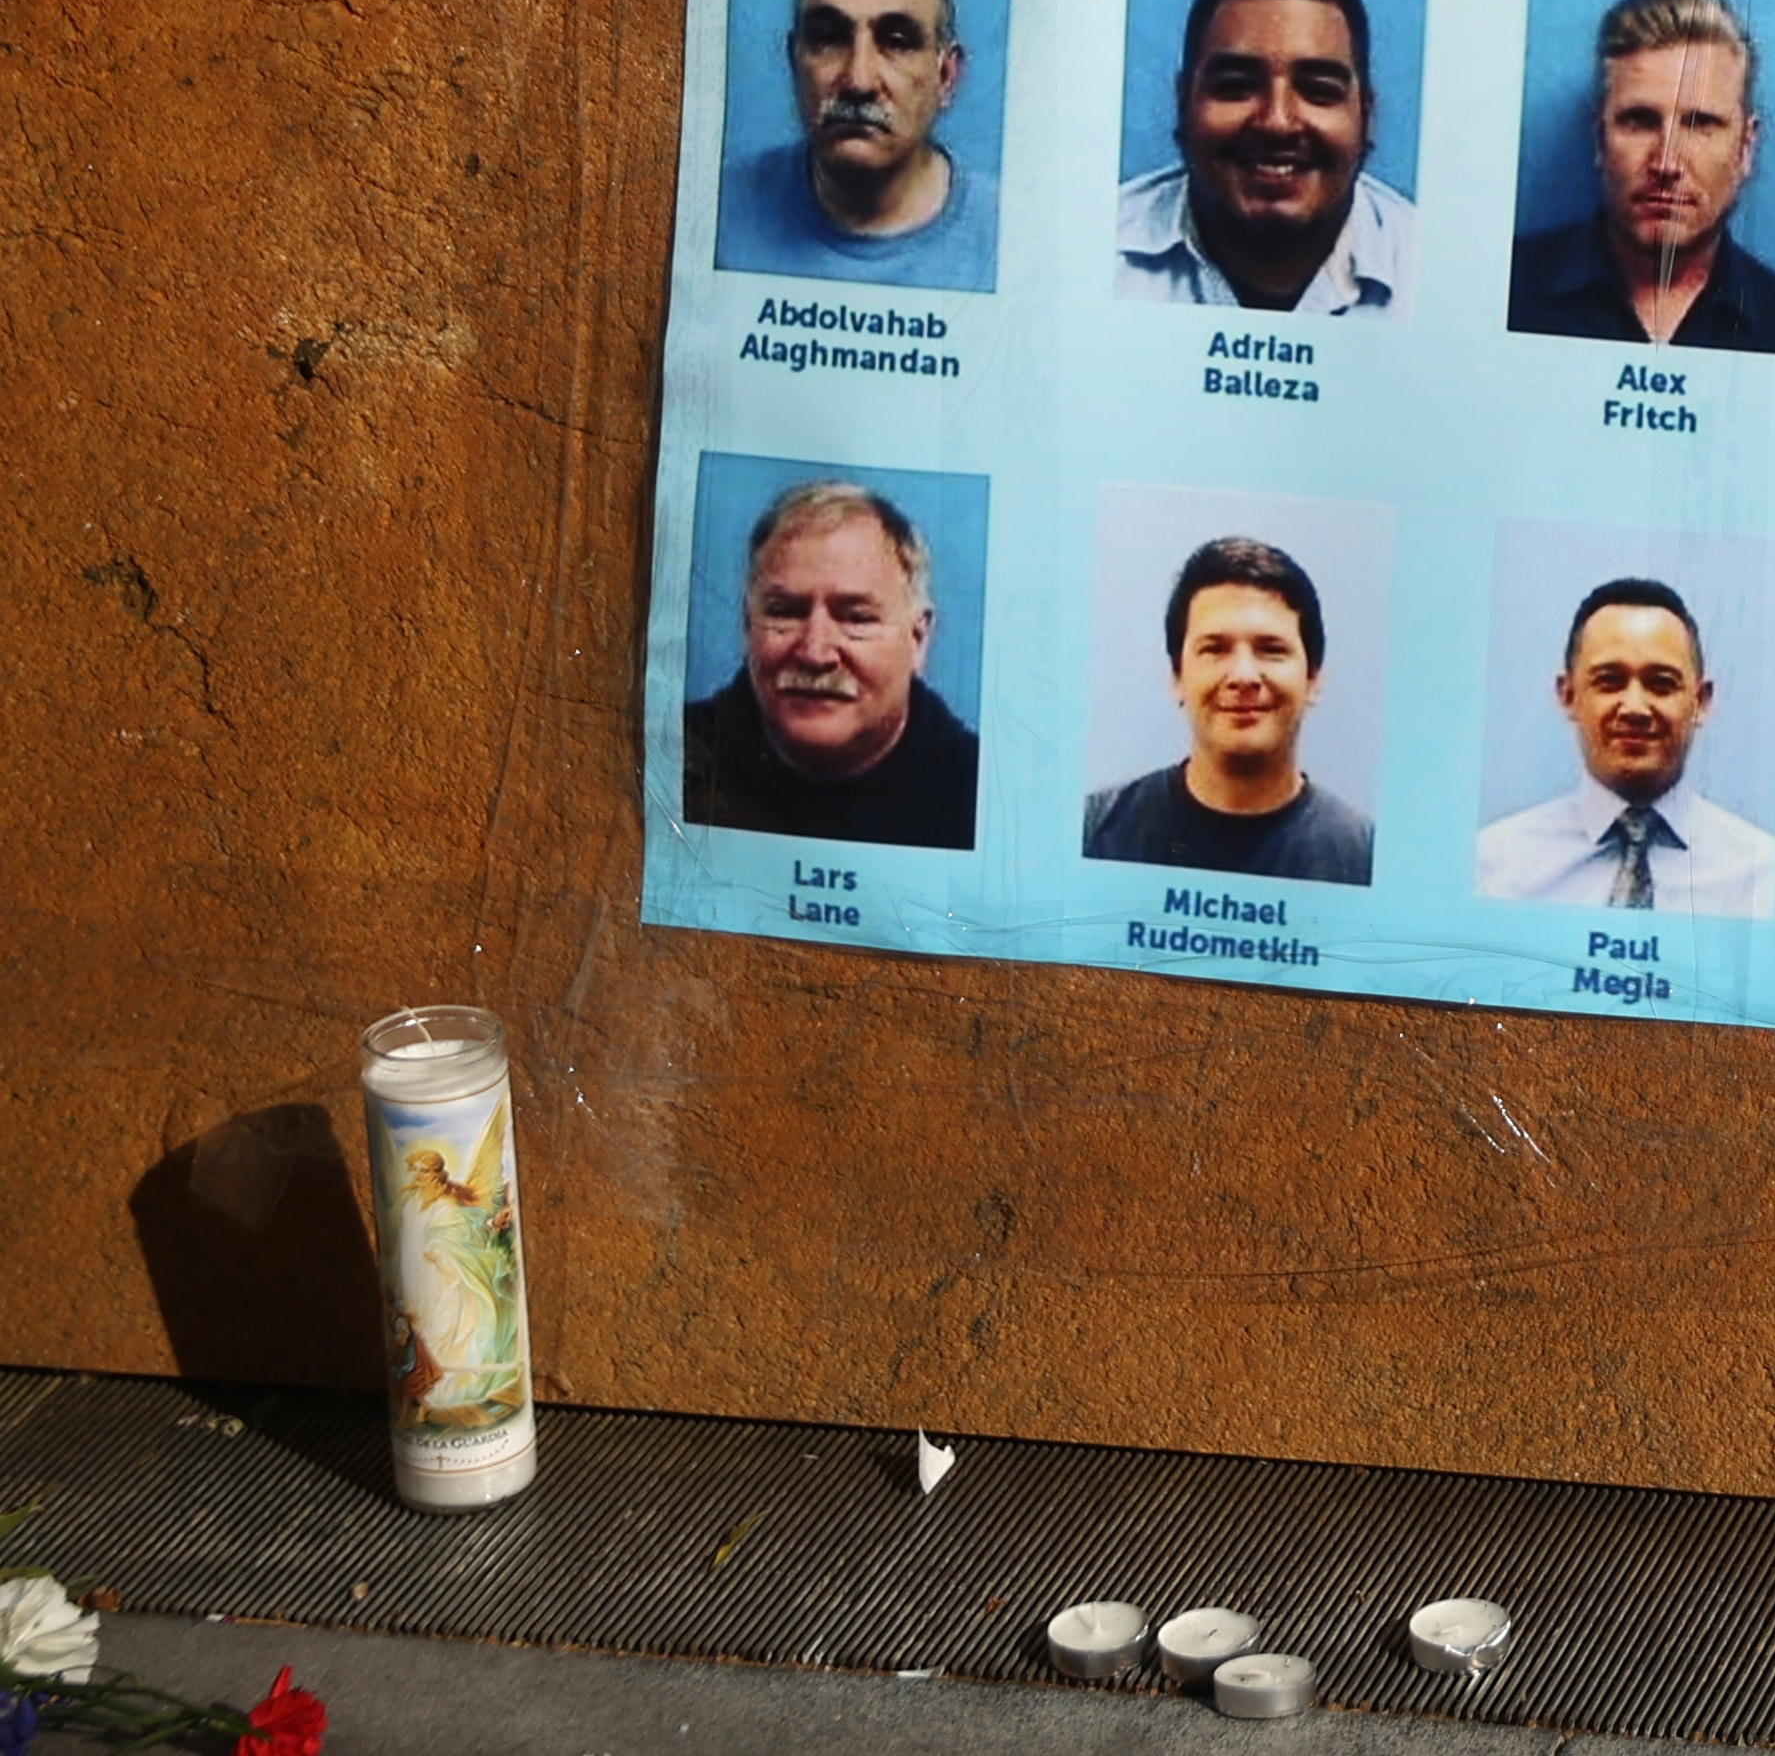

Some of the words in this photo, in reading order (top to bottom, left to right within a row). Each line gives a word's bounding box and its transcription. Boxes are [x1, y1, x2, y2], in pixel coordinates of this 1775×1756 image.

[757, 297, 948, 339] Abdolvahab
[739, 332, 960, 378] Alaghmandan
[1207, 331, 1314, 366] Adrian
[1203, 367, 1320, 403] Balleza
[1616, 363, 1687, 396] Alex
[1603, 399, 1698, 434] Fritch
[793, 859, 857, 892] Lars
[787, 894, 861, 927] Lane
[1163, 888, 1287, 927] Michael
[1127, 921, 1319, 967] Rudometkin
[1588, 931, 1660, 962] Paul
[1572, 966, 1671, 1005] Megia
